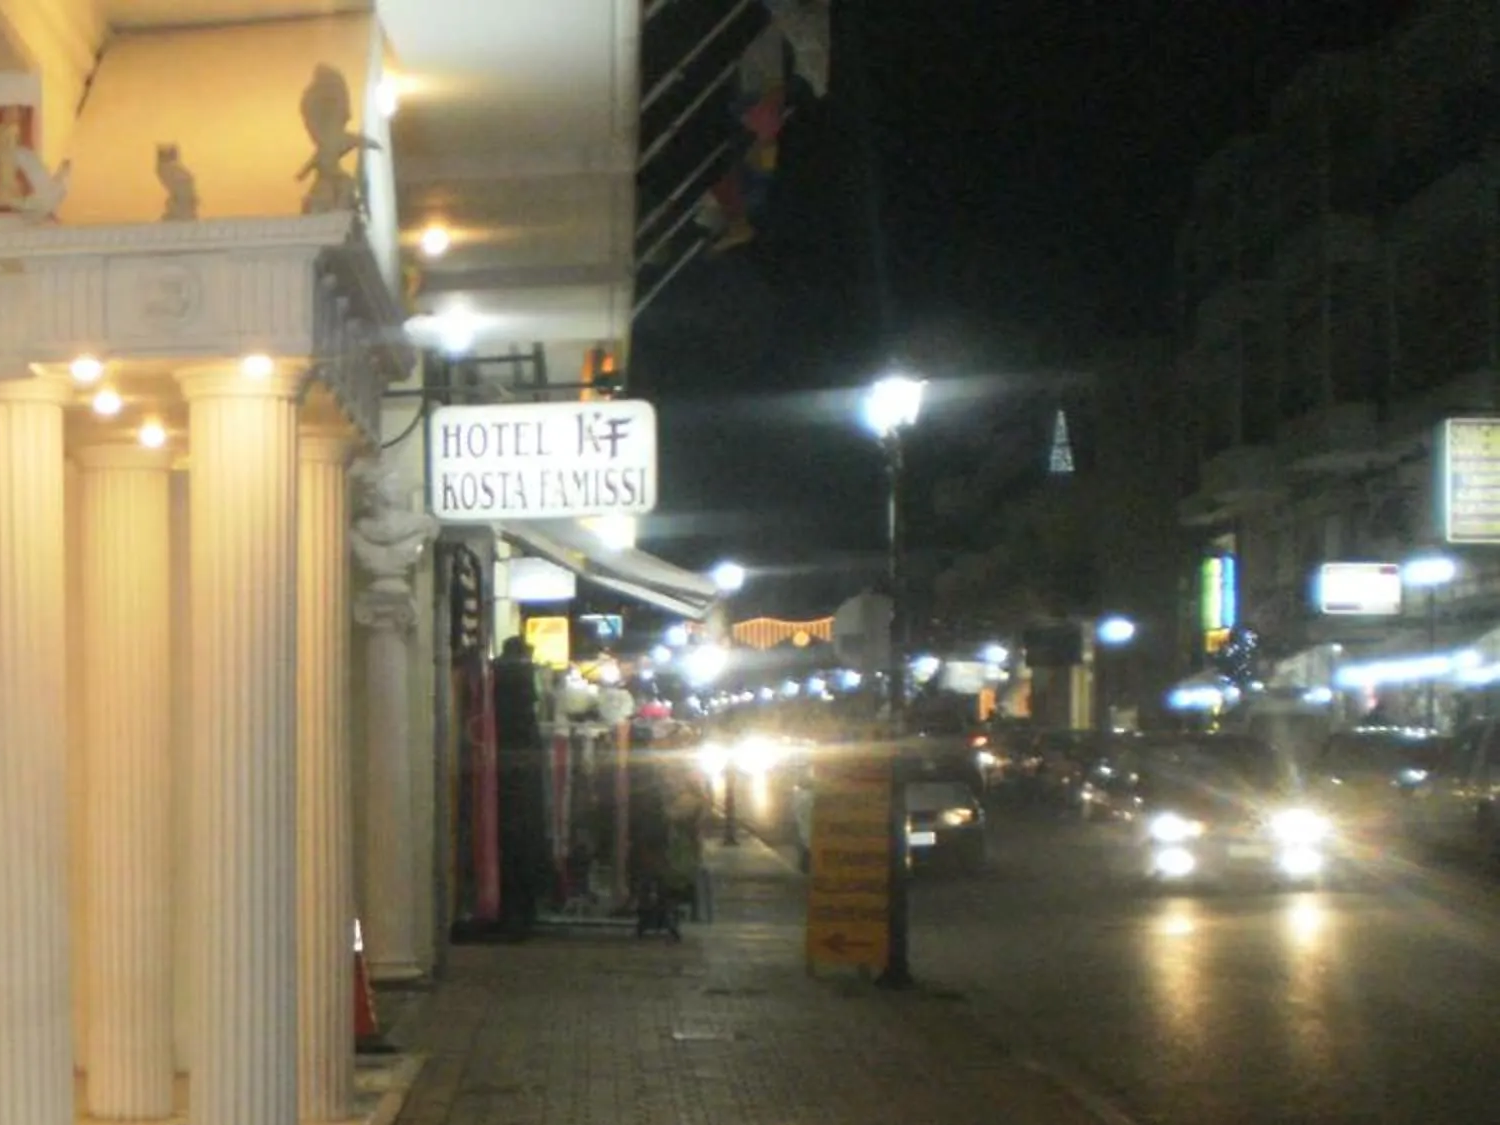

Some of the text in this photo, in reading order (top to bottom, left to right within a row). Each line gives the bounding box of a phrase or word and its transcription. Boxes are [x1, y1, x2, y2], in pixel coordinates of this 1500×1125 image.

[441, 421, 551, 458] HOTEL
[441, 467, 648, 511] KOSTA FAMISSI
